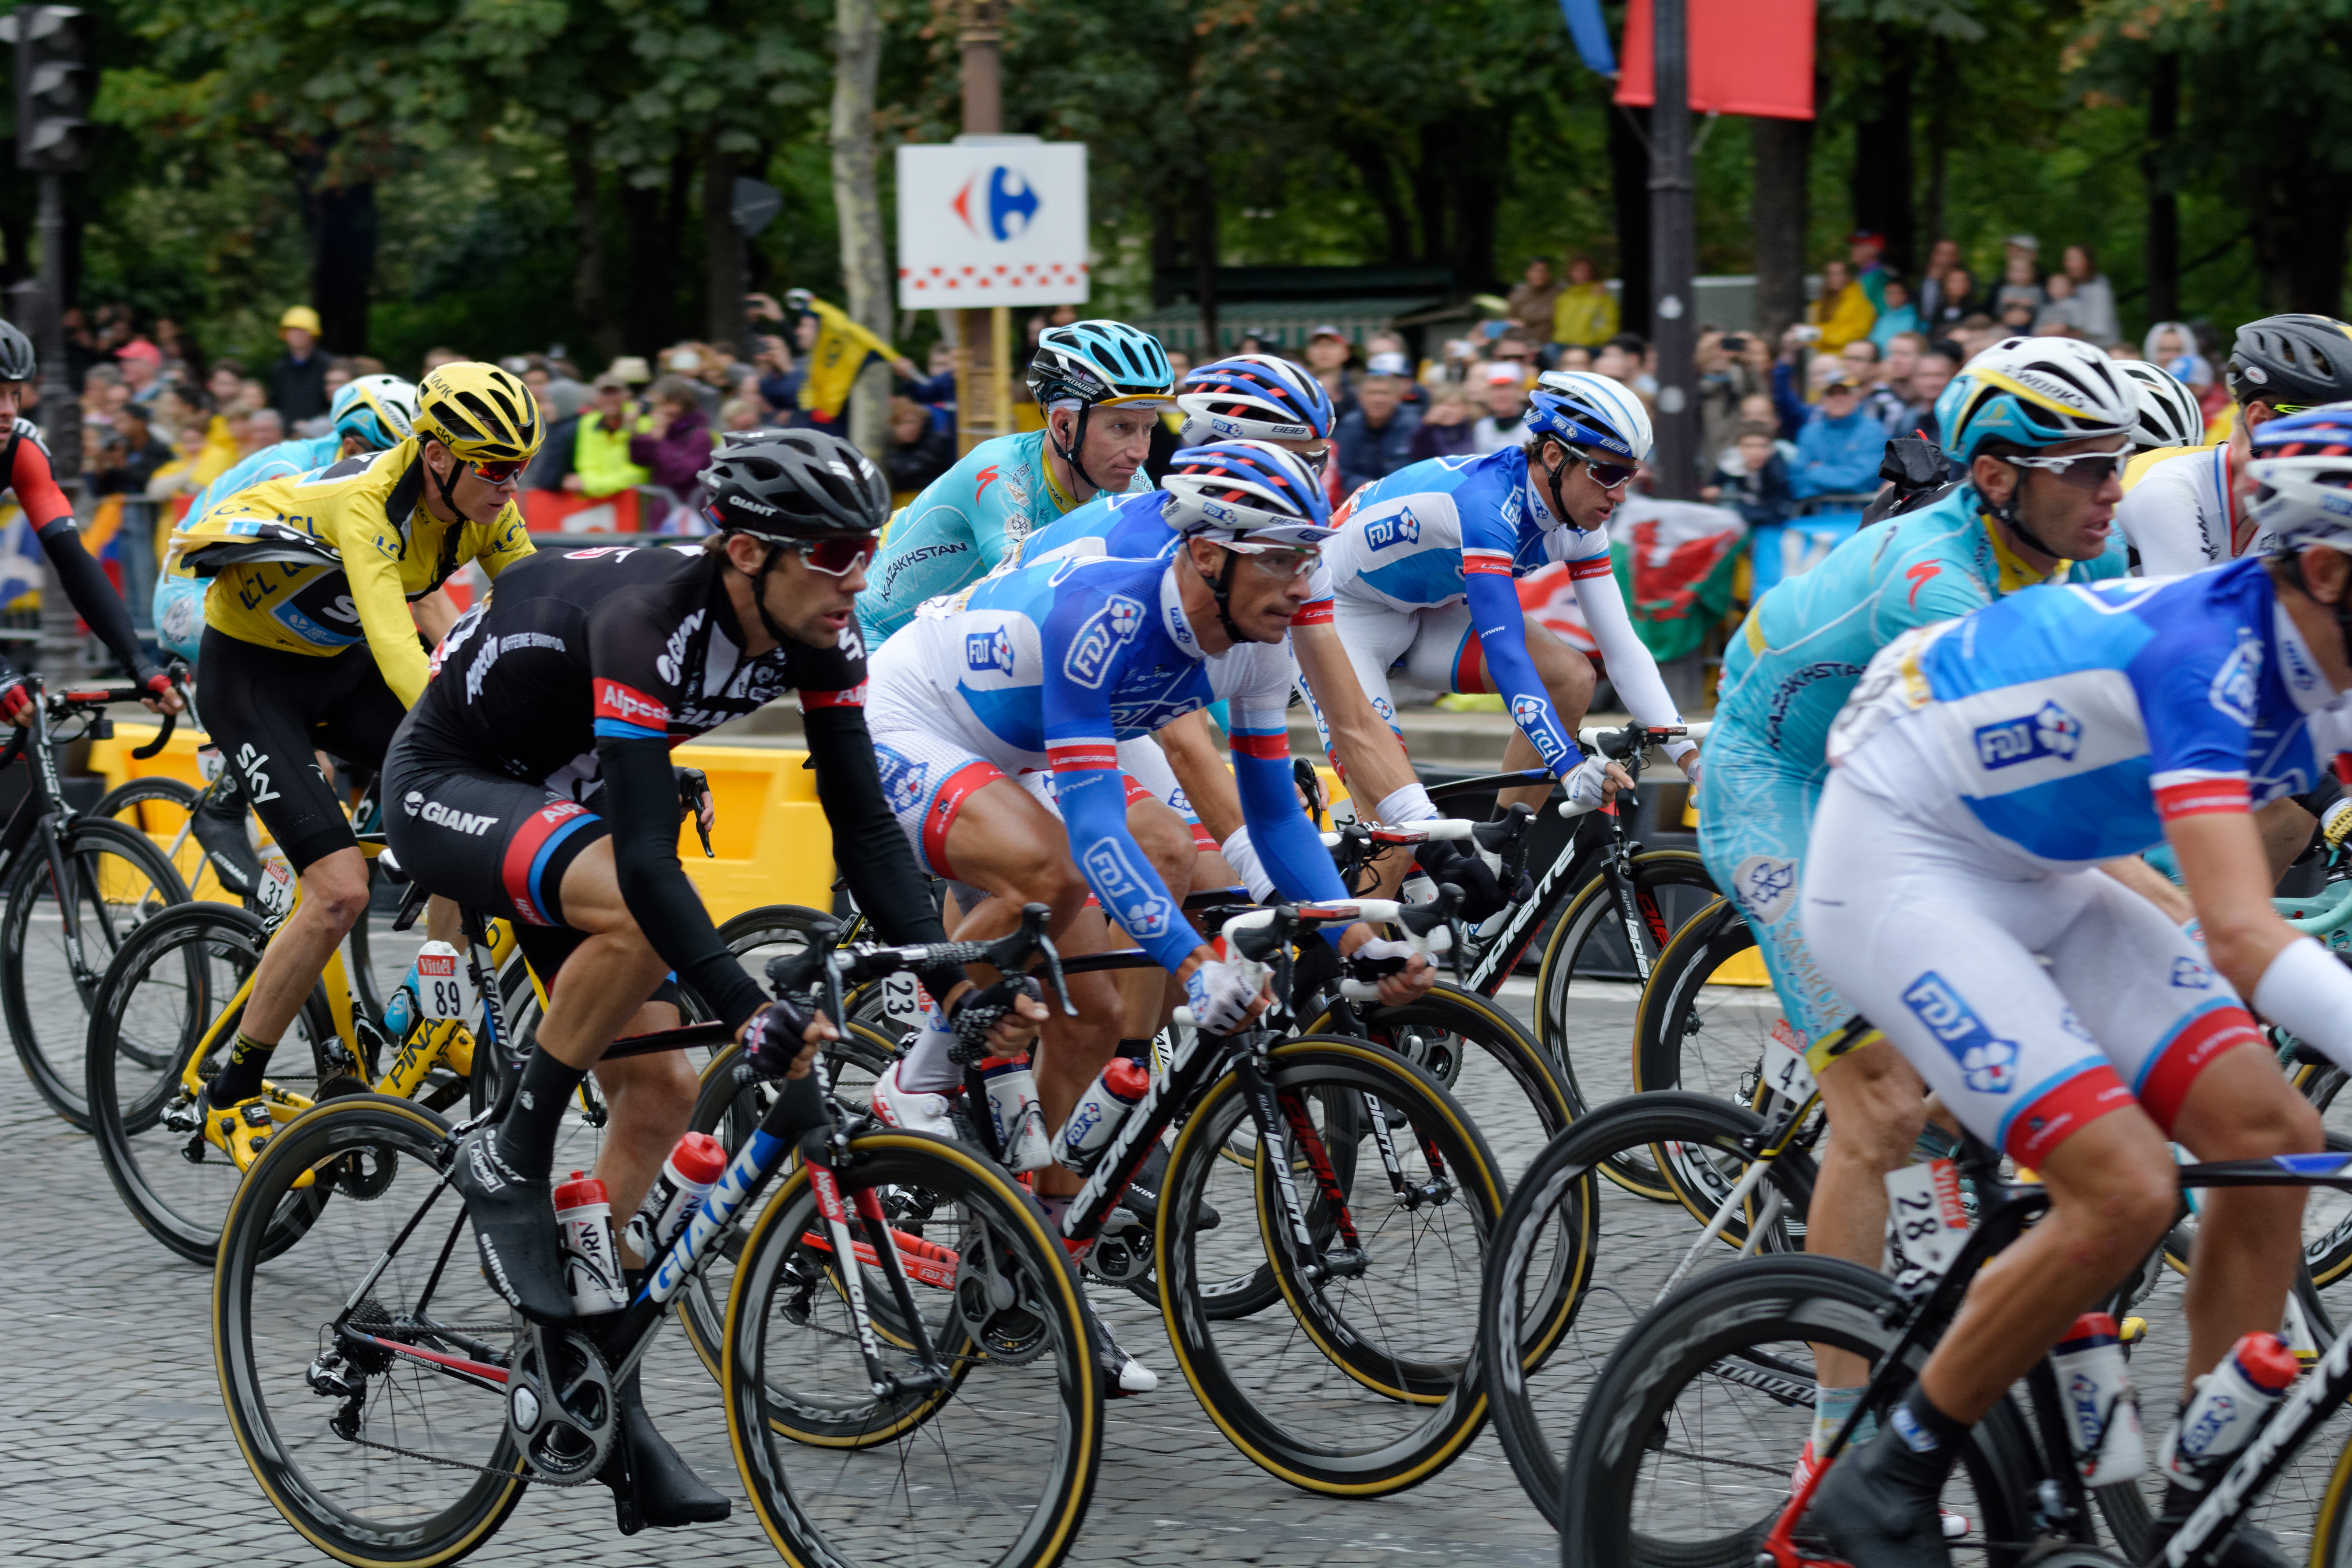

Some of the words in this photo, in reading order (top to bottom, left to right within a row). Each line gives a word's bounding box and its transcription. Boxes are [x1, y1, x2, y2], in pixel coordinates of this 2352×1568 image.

[429, 373, 453, 399] KASK
[1061, 375, 1098, 395] SPECIALIZED
[1062, 385, 1093, 401] ASTANA
[1213, 420, 1228, 432] FDJ
[1270, 425, 1307, 435] BBB
[1526, 413, 1543, 426] BBB
[1553, 418, 1567, 430] FDJ
[435, 426, 456, 446] sky
[1600, 438, 1630, 454] BBB
[729, 495, 777, 517] GIANT
[1203, 503, 1222, 516] FDJ
[1301, 531, 1322, 541] FDJ
[1368, 521, 1394, 548] FDJ
[881, 542, 968, 603] KAZAKHSTAN
[666, 608, 706, 665] GIAN
[969, 639, 990, 664] FDJ
[1074, 623, 1110, 678] FDJ
[1530, 728, 1559, 760] FDJ
[1982, 725, 2032, 763] FDJ
[236, 743, 281, 804] sky
[421, 802, 499, 836] GIANT
[265, 860, 288, 885] Vittel
[1091, 851, 1137, 898] FDJ
[264, 881, 282, 913] 31
[1466, 838, 1573, 992] apierre
[420, 958, 452, 975] Vittel
[1781, 921, 1844, 1025] SAMRUK
[435, 981, 460, 1016] 89
[485, 976, 512, 1050] GIANT
[885, 980, 915, 1015] 23
[1906, 982, 1964, 1041] FDJ
[1067, 1120, 1086, 1145] FDJ
[1363, 1091, 1400, 1173] pierre
[470, 1149, 497, 1187] Alpecin
[815, 1171, 840, 1217] Alpecin
[649, 1136, 763, 1303] GIANT
[1896, 1191, 1939, 1241] 28
[477, 1233, 521, 1307] SHIMANO
[921, 1267, 940, 1281] FDJ
[849, 1284, 880, 1359] GIANT
[393, 1349, 441, 1371] SHIMANO
